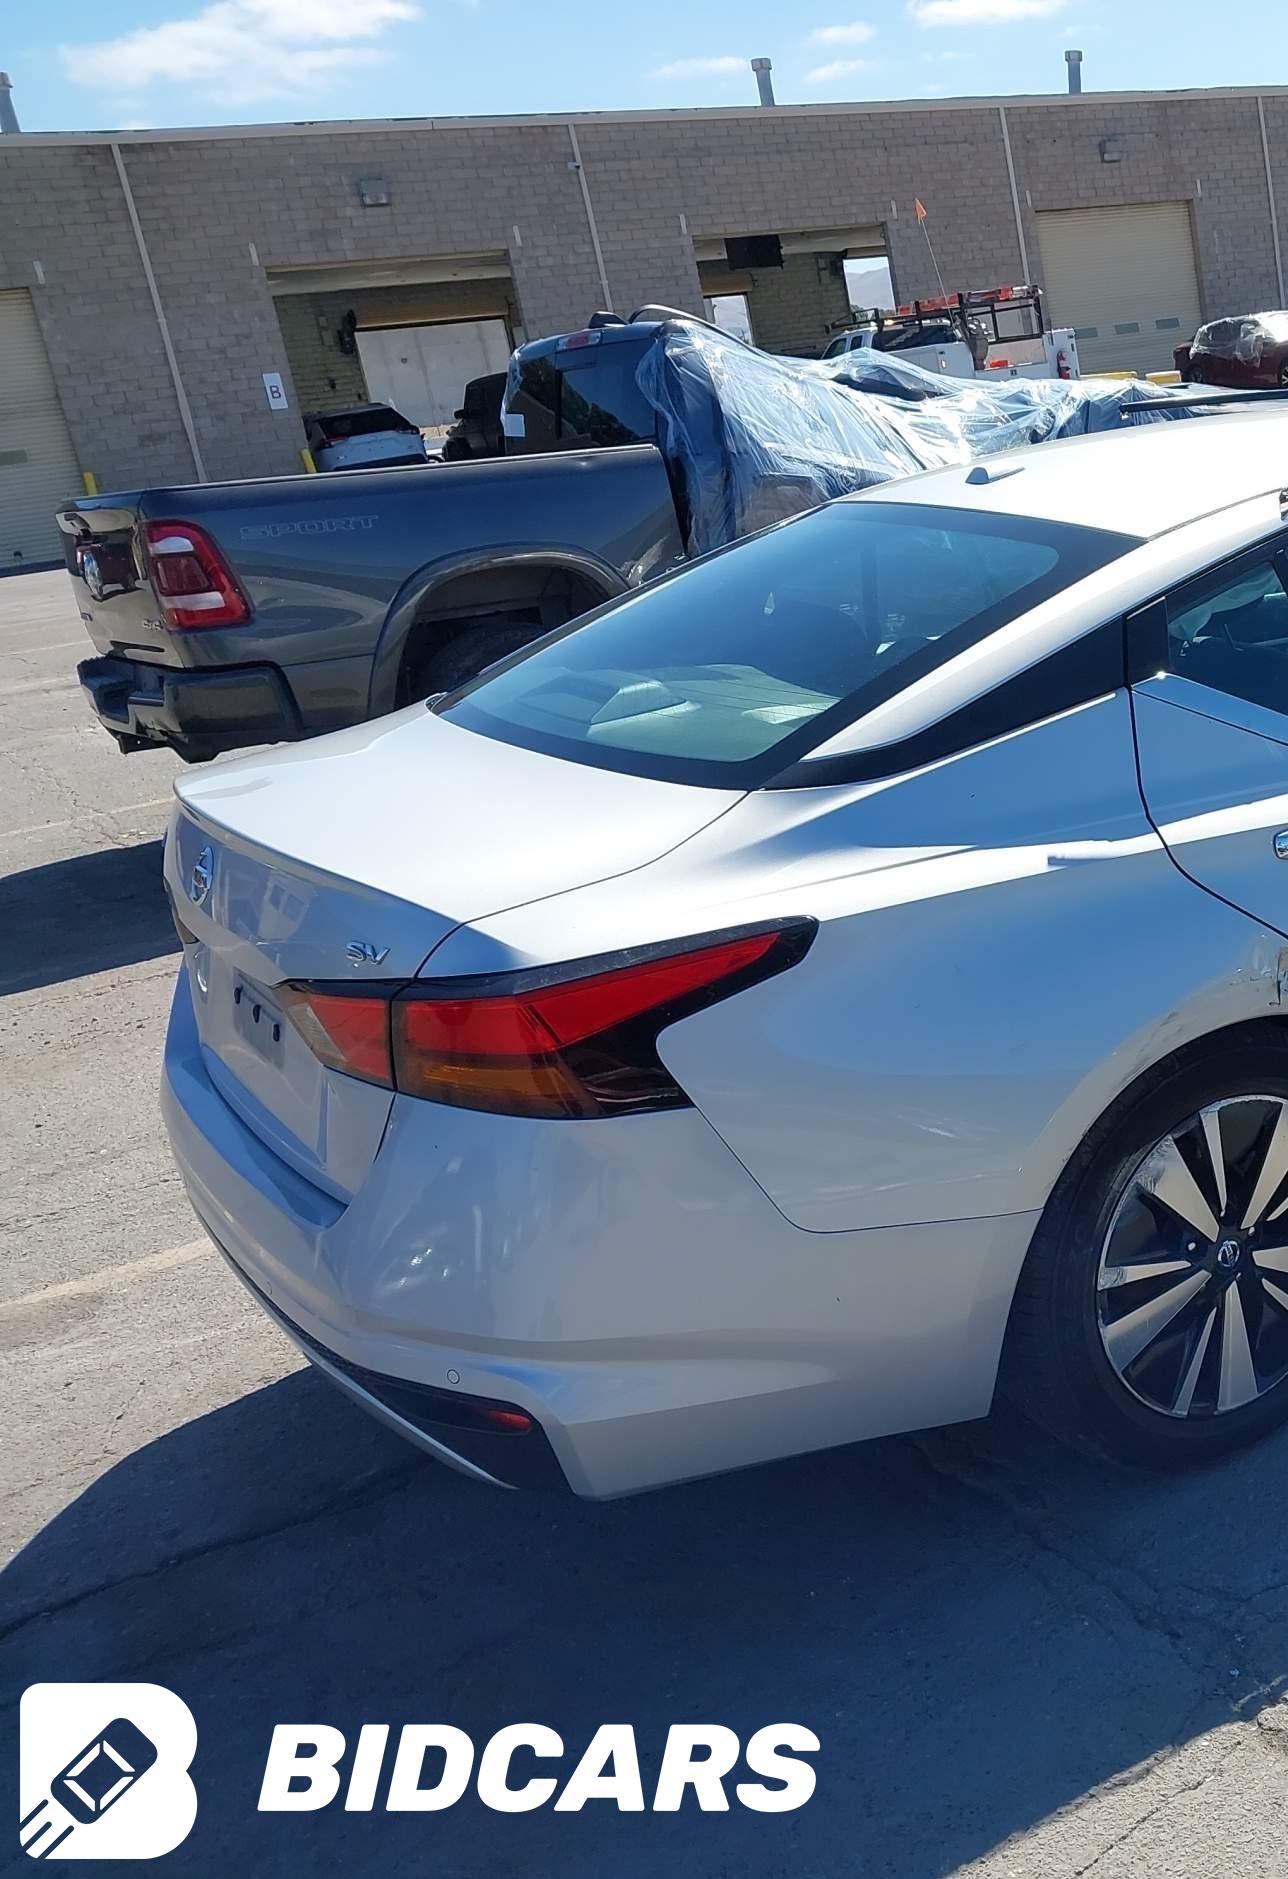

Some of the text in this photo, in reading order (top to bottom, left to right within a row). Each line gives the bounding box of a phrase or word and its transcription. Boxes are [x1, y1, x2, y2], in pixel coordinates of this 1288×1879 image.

[270, 385, 281, 399] B
[239, 514, 379, 538] SPORT
[345, 940, 391, 965] SV
